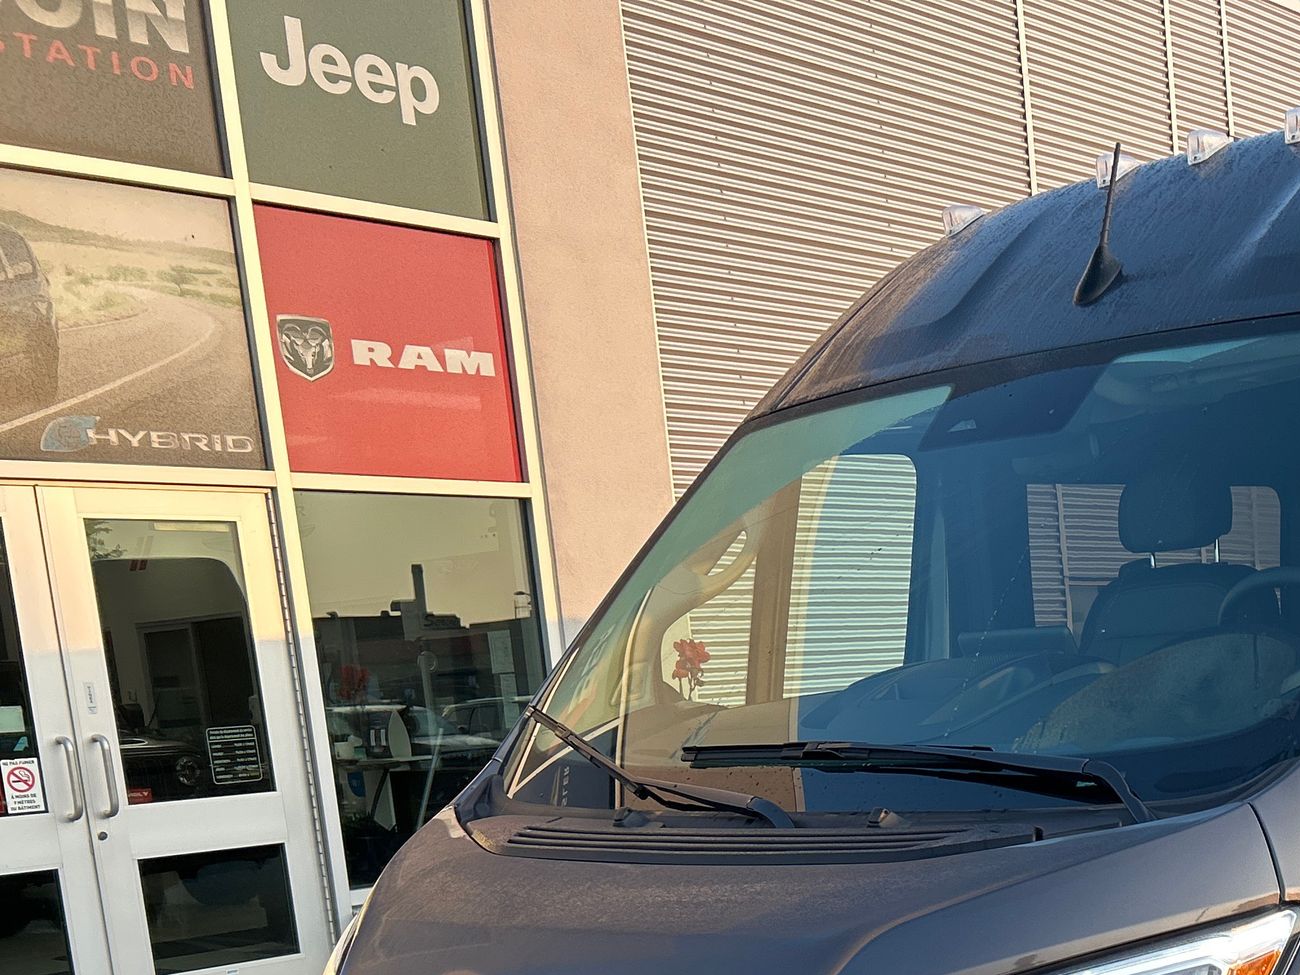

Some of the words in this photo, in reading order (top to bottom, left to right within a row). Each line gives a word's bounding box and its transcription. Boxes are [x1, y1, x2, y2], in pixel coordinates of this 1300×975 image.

[0, 31, 195, 89] TATION
[259, 15, 440, 126] Jeep
[350, 338, 496, 377] RAM
